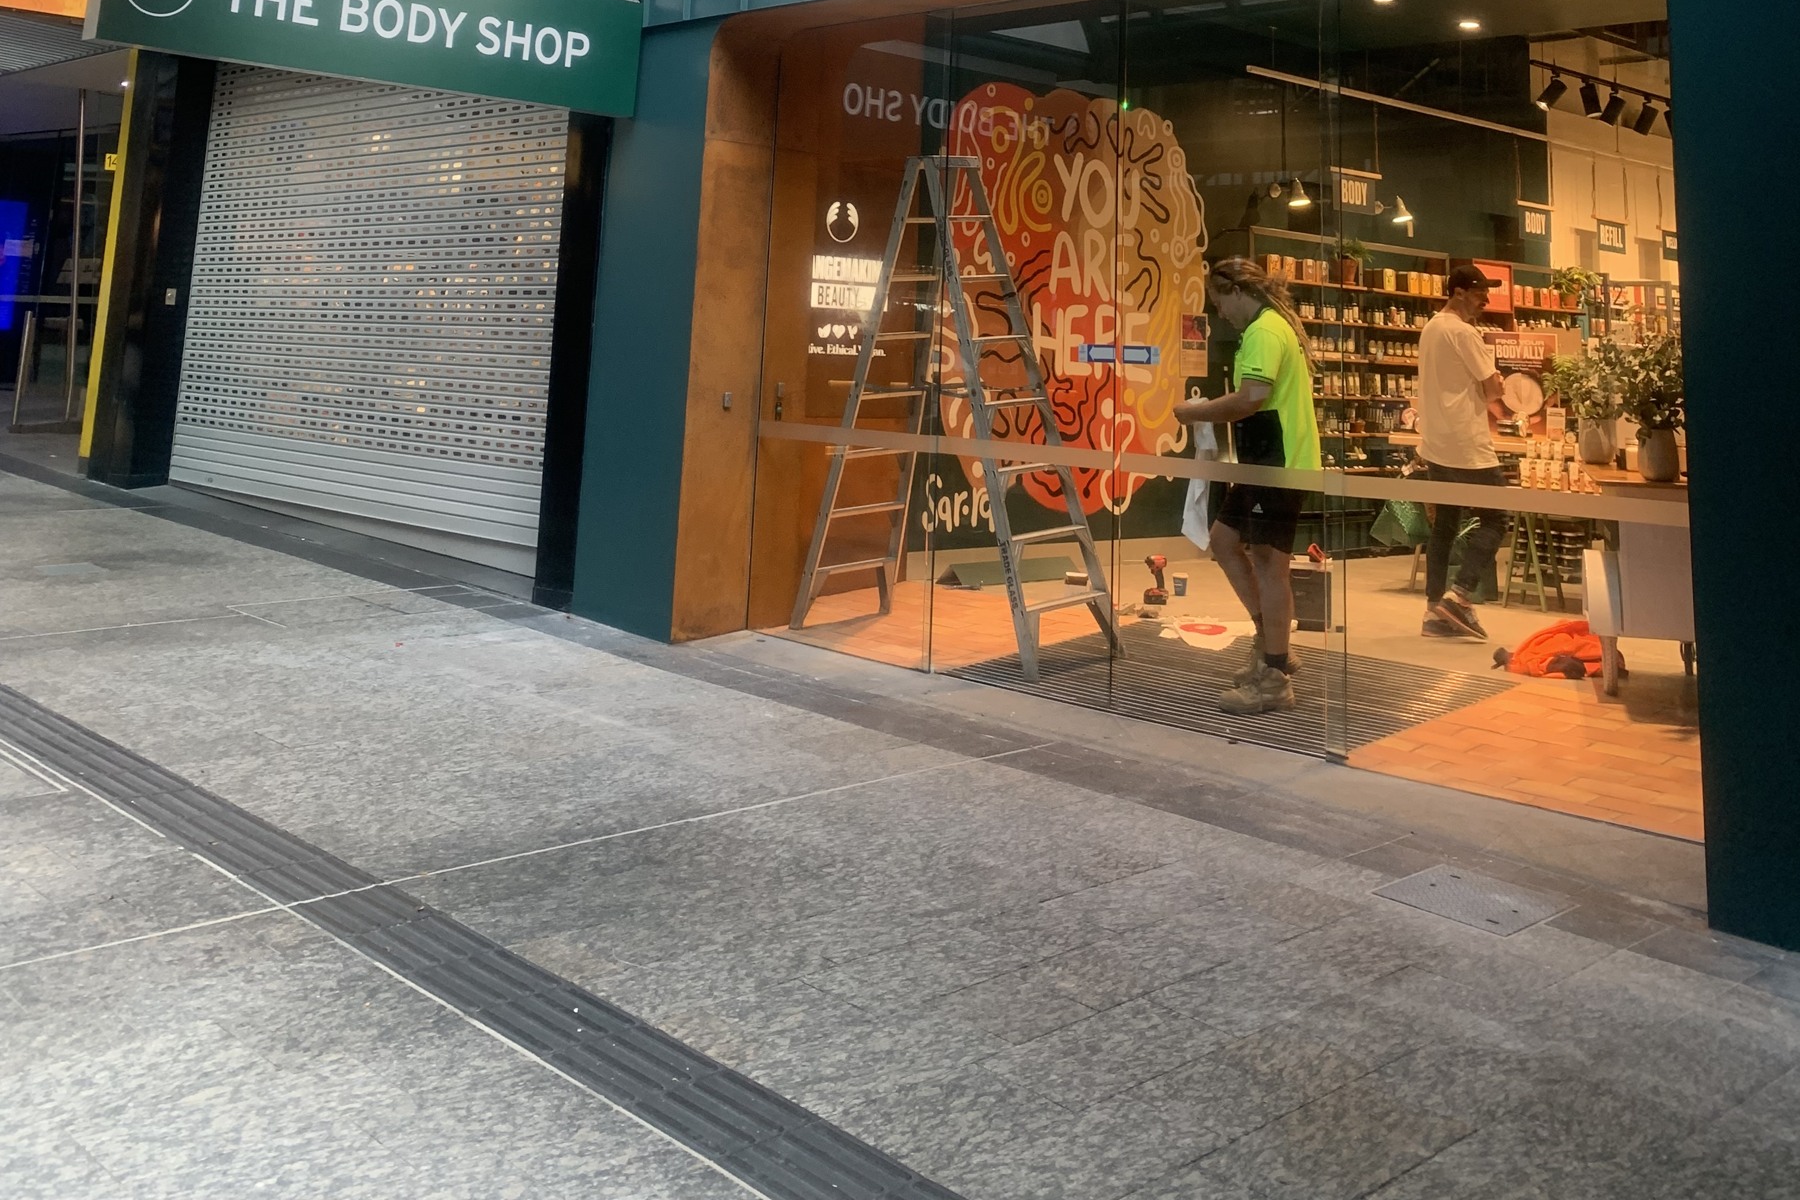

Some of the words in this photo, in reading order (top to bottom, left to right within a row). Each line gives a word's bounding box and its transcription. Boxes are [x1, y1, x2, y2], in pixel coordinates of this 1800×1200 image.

[475, 15, 591, 68] SHOP
[1054, 152, 1141, 230] YOU
[1341, 179, 1368, 206] BODY
[1525, 211, 1546, 235] BODY
[1600, 224, 1624, 248] REFILL
[1050, 229, 1136, 306] ARE
[817, 285, 860, 307] BEAUTY
[1033, 302, 1153, 384] HERE
[1496, 344, 1521, 359] BODY
[1522, 345, 1545, 360] ALLY
[999, 541, 1012, 575] TRADE
[1005, 576, 1018, 610] GLASS
